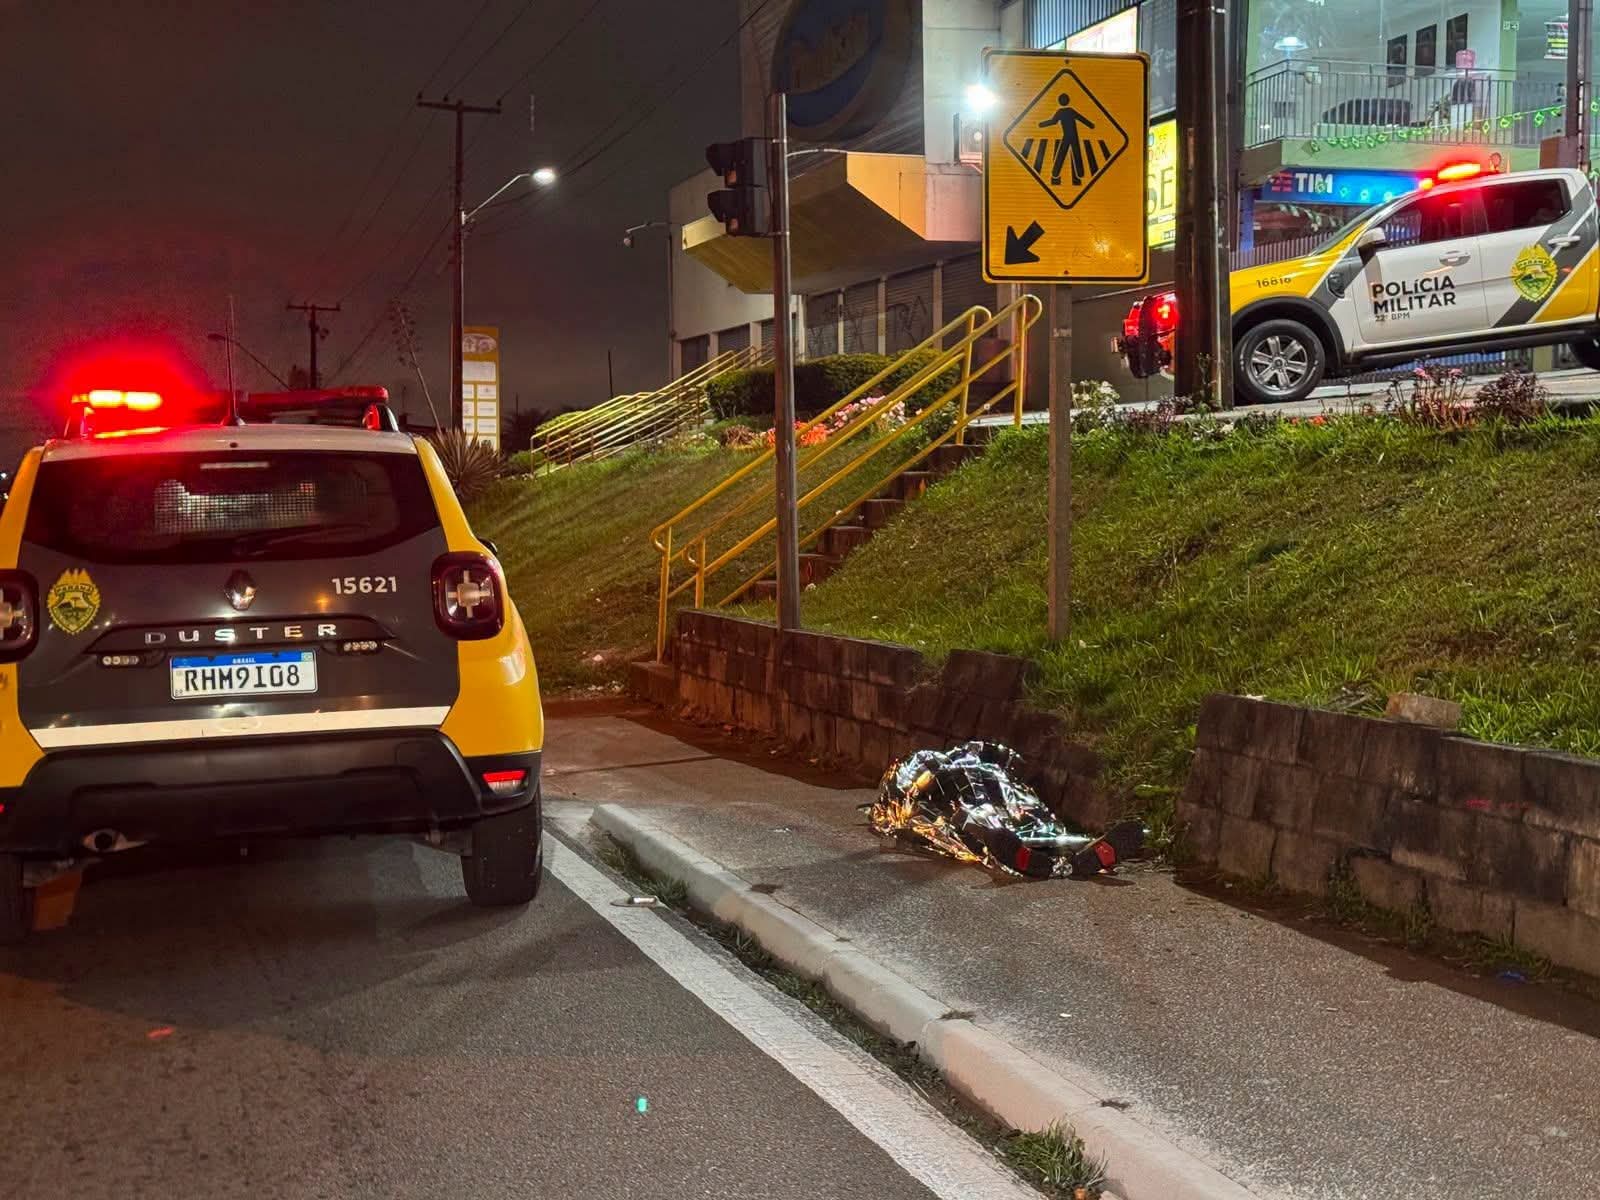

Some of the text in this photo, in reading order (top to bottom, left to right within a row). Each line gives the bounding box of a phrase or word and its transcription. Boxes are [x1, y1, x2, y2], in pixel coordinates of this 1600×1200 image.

[1295, 172, 1334, 194] TIM
[1373, 292, 1457, 315] MILITAR
[332, 576, 398, 595] 15621
[144, 623, 337, 645] DUSTER
[184, 664, 300, 692] RHM9I08
